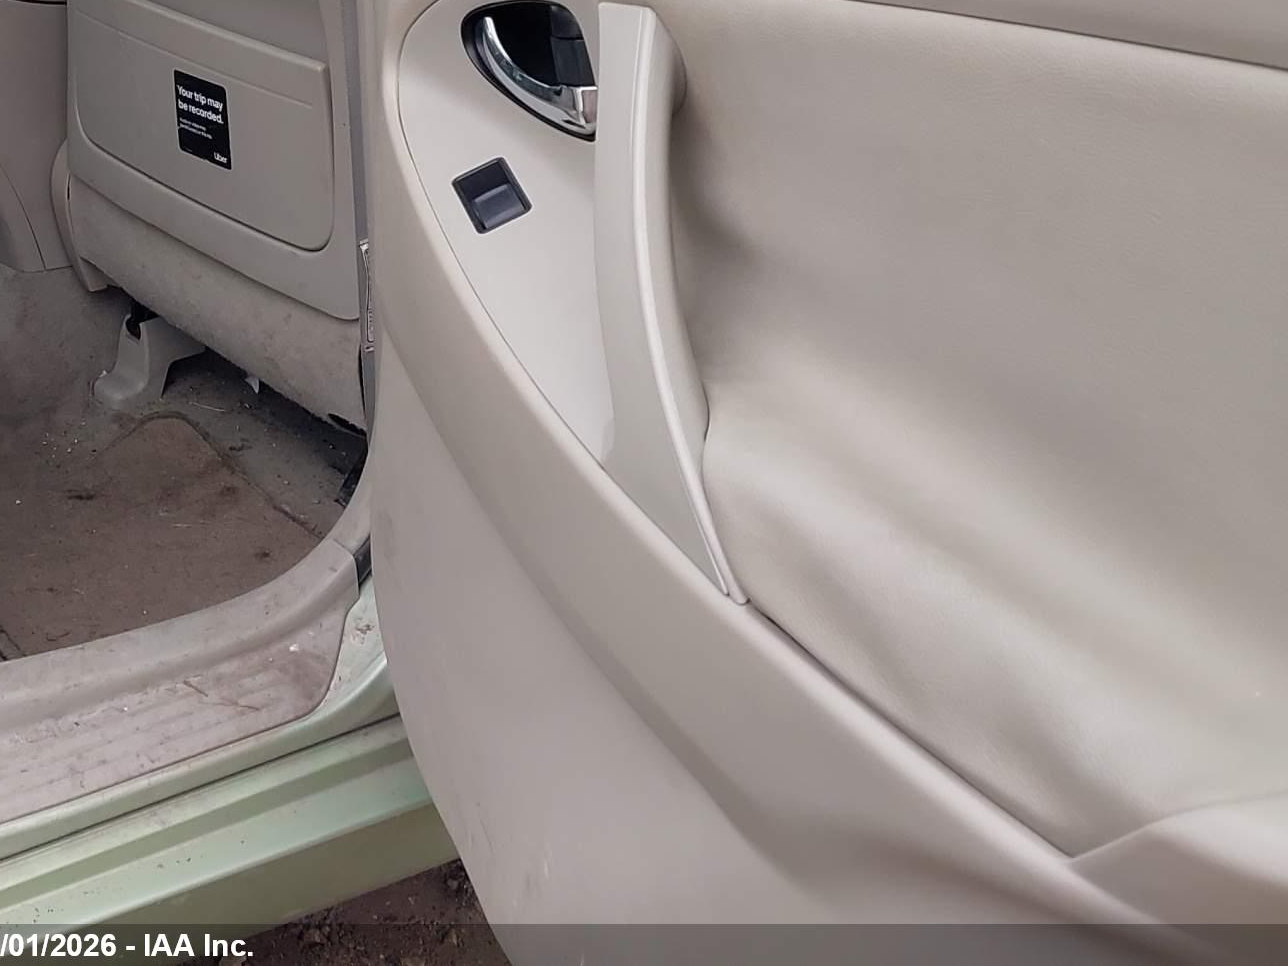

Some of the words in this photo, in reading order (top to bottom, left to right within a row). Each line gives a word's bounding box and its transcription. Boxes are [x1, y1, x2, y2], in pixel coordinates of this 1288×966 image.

[176, 84, 193, 99] Your
[194, 92, 206, 105] trip
[207, 97, 223, 112] may
[178, 99, 188, 111] be
[188, 104, 224, 124] recorded.
[214, 151, 228, 164] Uber
